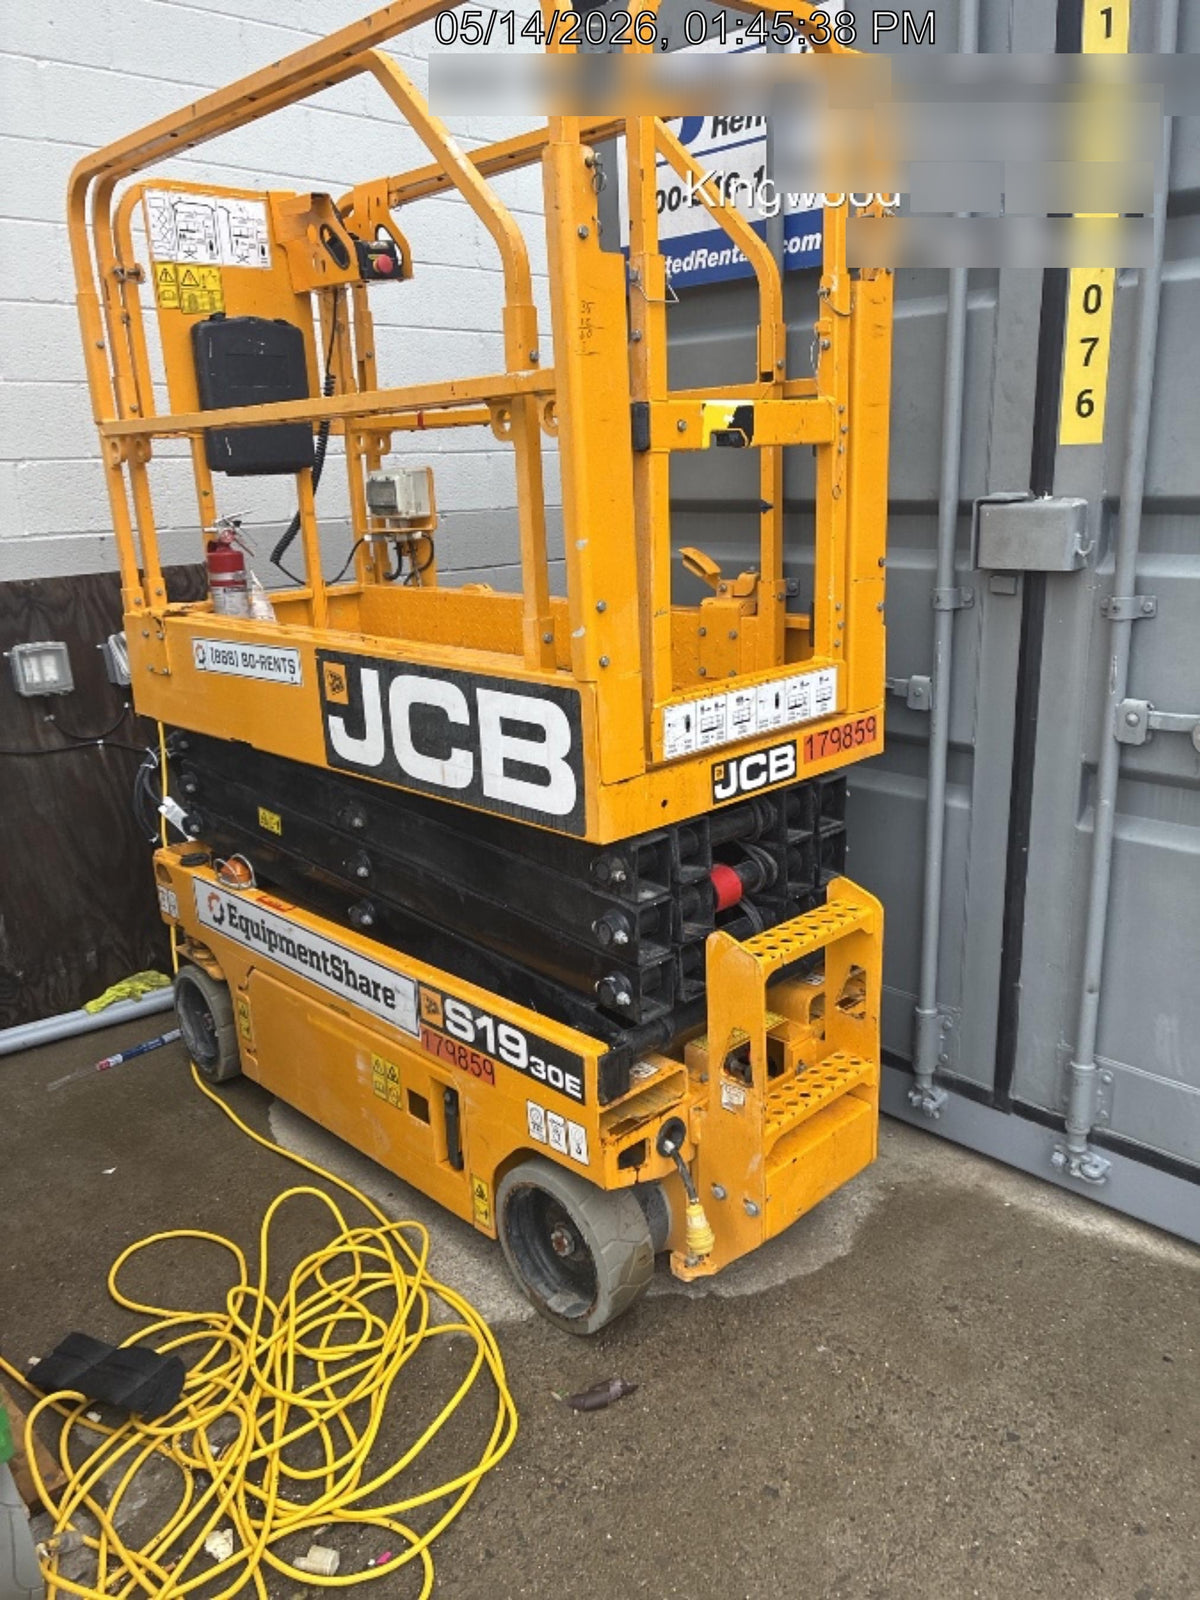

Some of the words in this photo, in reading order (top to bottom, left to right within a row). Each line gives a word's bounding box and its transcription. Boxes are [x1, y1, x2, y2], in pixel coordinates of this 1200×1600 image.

[711, 115, 768, 140] Ren
[327, 667, 577, 816] JCB
[805, 717, 876, 759] 179859
[713, 743, 797, 800] JCB
[226, 902, 396, 1010] EquipmentShare
[422, 1030, 495, 1085] 179859
